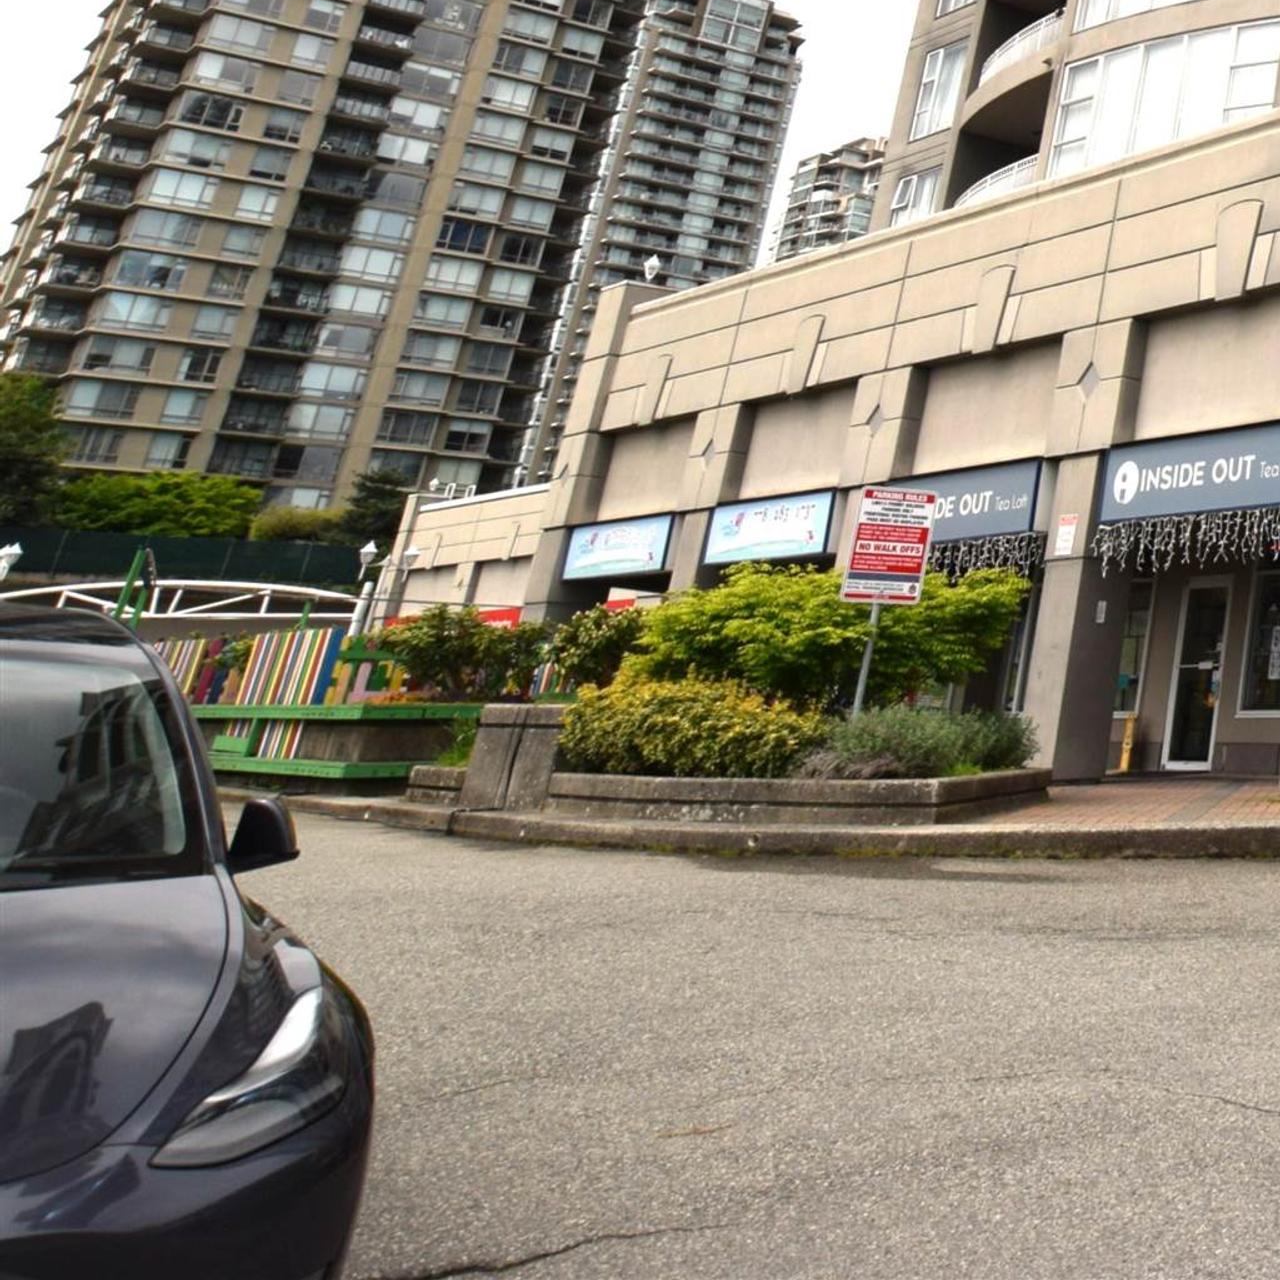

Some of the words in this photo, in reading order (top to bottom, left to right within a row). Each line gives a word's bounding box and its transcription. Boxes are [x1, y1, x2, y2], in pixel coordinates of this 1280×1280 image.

[1139, 461, 1206, 492] INSIDE
[1212, 454, 1255, 484] OUT
[1259, 461, 1280, 479] Tea
[959, 491, 993, 514] OUT
[995, 495, 1009, 510] Tea
[1010, 494, 1027, 510] Loft
[859, 543, 871, 551] NO
[873, 544, 898, 553] WALK
[900, 546, 921, 554] OFFS
